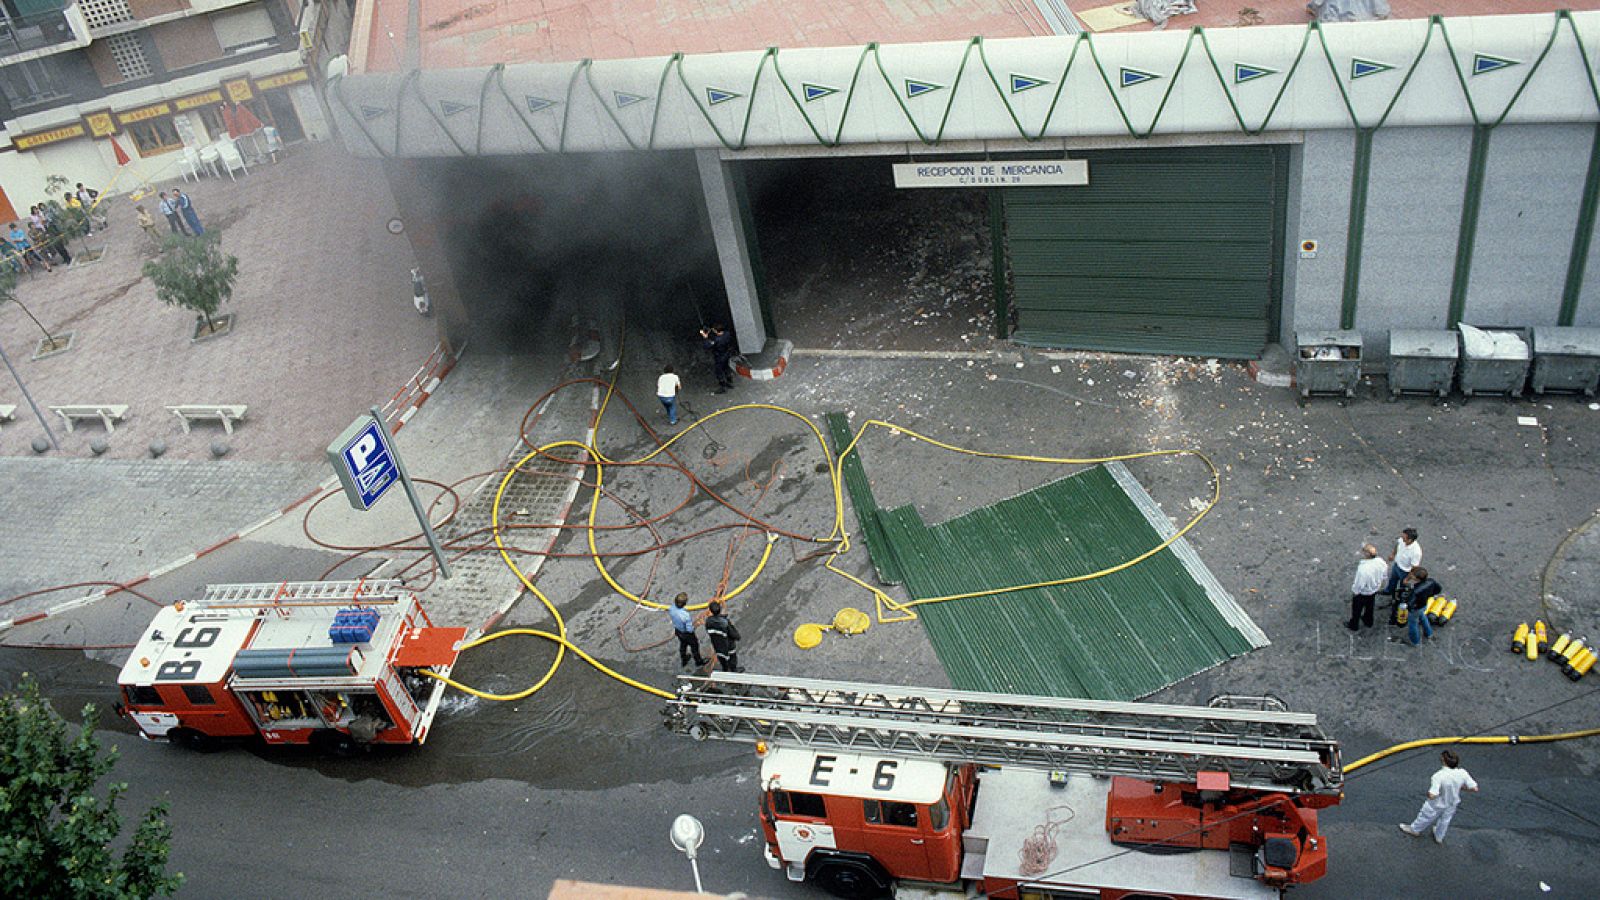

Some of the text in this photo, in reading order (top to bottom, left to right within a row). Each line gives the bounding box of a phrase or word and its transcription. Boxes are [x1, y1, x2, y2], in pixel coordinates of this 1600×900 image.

[980, 165, 996, 175] DE
[1001, 165, 1063, 176] MERCANCIA
[349, 433, 376, 472] P
[809, 754, 898, 791] E-6
